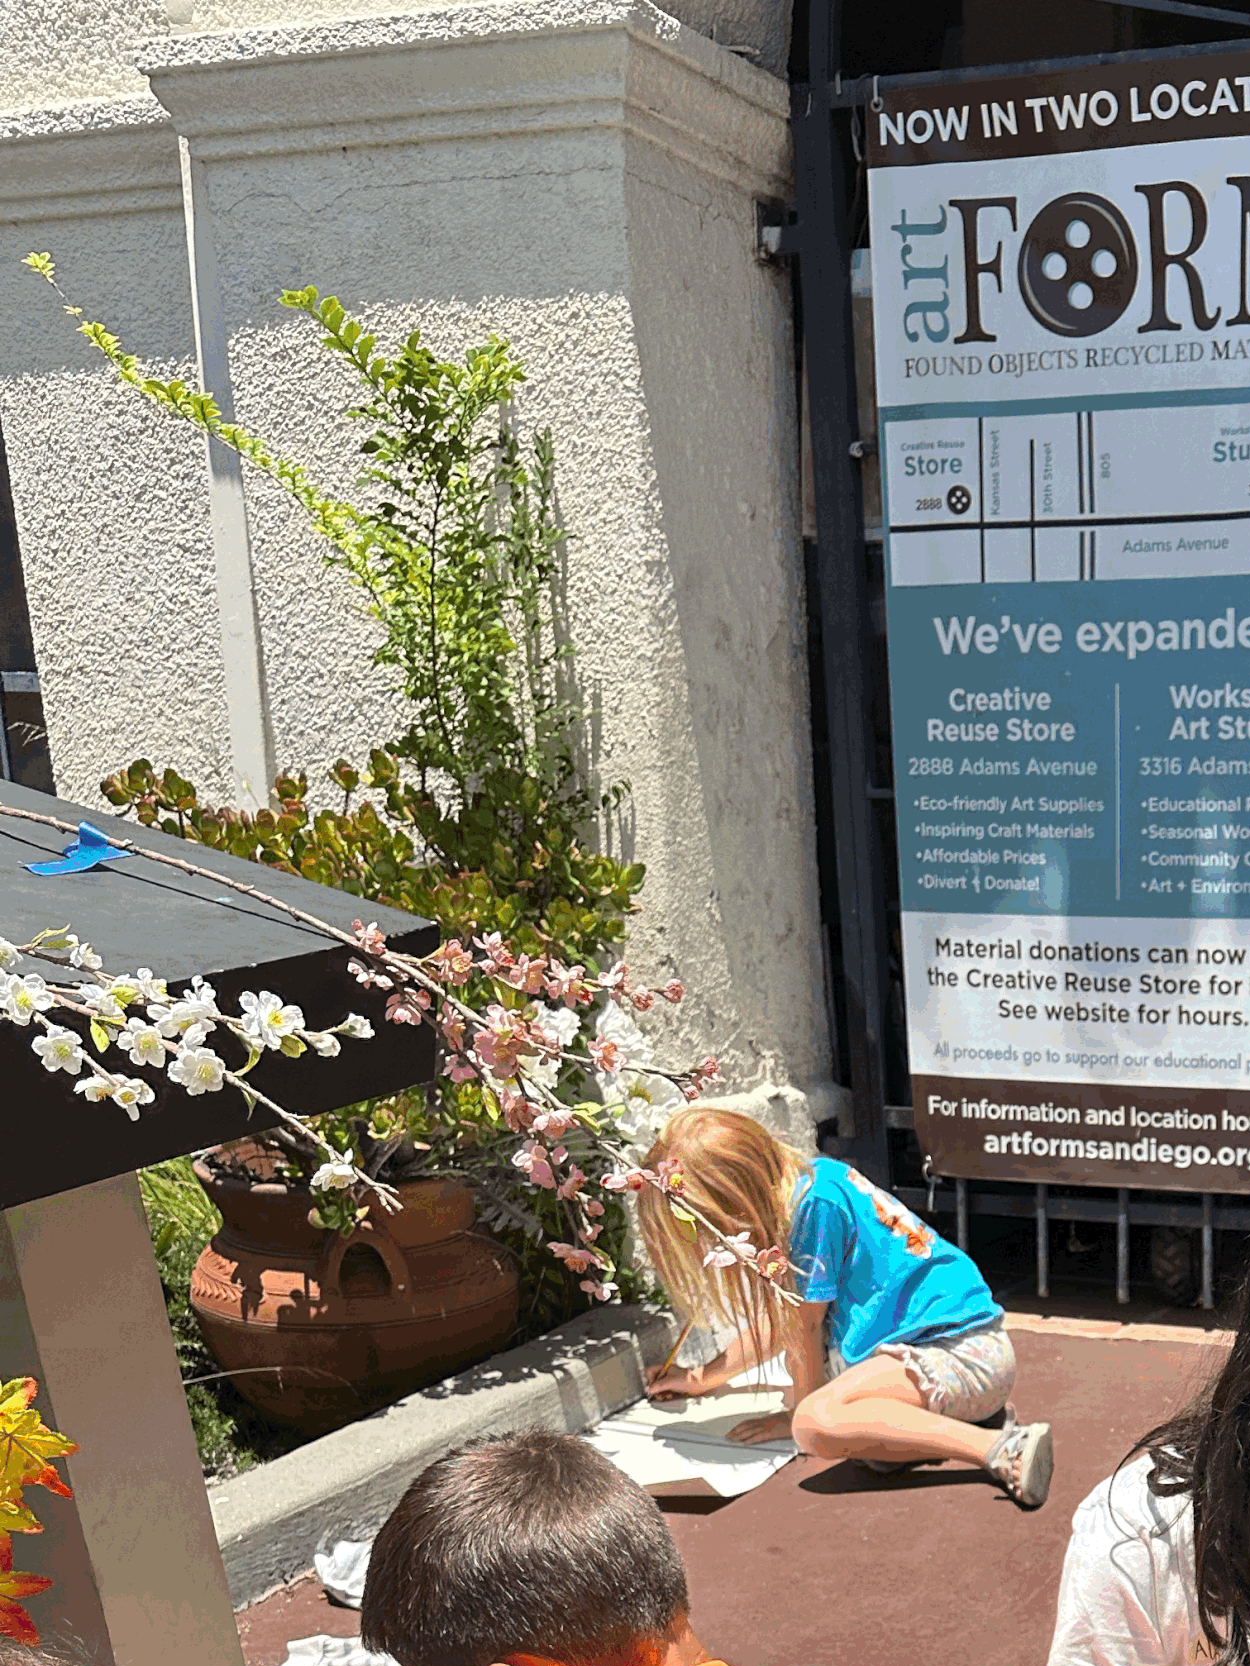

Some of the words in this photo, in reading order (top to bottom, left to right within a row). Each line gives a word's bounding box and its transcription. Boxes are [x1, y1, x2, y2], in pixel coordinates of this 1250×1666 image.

[878, 106, 968, 146] NOW
[980, 102, 1018, 140] IN
[1025, 90, 1119, 133] TWO
[890, 204, 950, 344] art
[904, 355, 983, 378] FOUND
[988, 350, 1079, 378] OBJECTS
[1084, 342, 1204, 369] RECYCLED
[901, 442, 934, 452] Creative
[937, 440, 965, 450] Reuse
[990, 430, 1000, 468] Street
[904, 455, 962, 476] Store
[1043, 442, 1052, 481] Street
[1100, 453, 1110, 478] 805
[990, 472, 1000, 516] Kansas
[1043, 484, 1052, 513] 30th
[1122, 539, 1172, 552] Adams
[1176, 537, 1229, 552] Avenue
[949, 686, 1052, 712] Creative
[927, 718, 999, 742] Reuse
[1006, 718, 1076, 742] Store
[1168, 717, 1210, 741] Art
[908, 758, 954, 775] 2888
[959, 758, 1020, 775] Adams
[1026, 758, 1098, 776] Avenue
[1139, 756, 1182, 775] 3316
[1010, 797, 1034, 811] Art
[1038, 798, 1104, 814] Supplies
[988, 823, 1022, 837] Craft
[1026, 824, 1094, 838] Materials
[1003, 850, 1046, 864] Prices
[985, 876, 1040, 892] Donate!
[1177, 881, 1186, 890] +
[935, 938, 1022, 960] Material
[1028, 941, 1140, 964] donations
[1148, 949, 1188, 966] can
[1197, 949, 1246, 966] now
[927, 968, 959, 988] the
[966, 969, 1057, 991] Creative
[1064, 972, 1132, 994] Reuse
[1139, 974, 1202, 996] Store
[1210, 976, 1243, 996] for
[999, 1000, 1038, 1020] See
[1045, 1001, 1130, 1023] website
[1137, 1002, 1171, 1024] for
[1178, 1004, 1250, 1026] hours.
[934, 1042, 949, 1058] All
[954, 1044, 1018, 1062] proceeds
[1023, 1050, 1042, 1066] go
[1046, 1050, 1060, 1064] to
[1065, 1052, 1118, 1069] support
[1124, 1055, 1149, 1067] our
[1154, 1052, 1242, 1070] educational
[928, 1095, 958, 1117] For
[962, 1098, 1080, 1124] information
[1085, 1106, 1125, 1126] and
[1130, 1106, 1216, 1130] location
